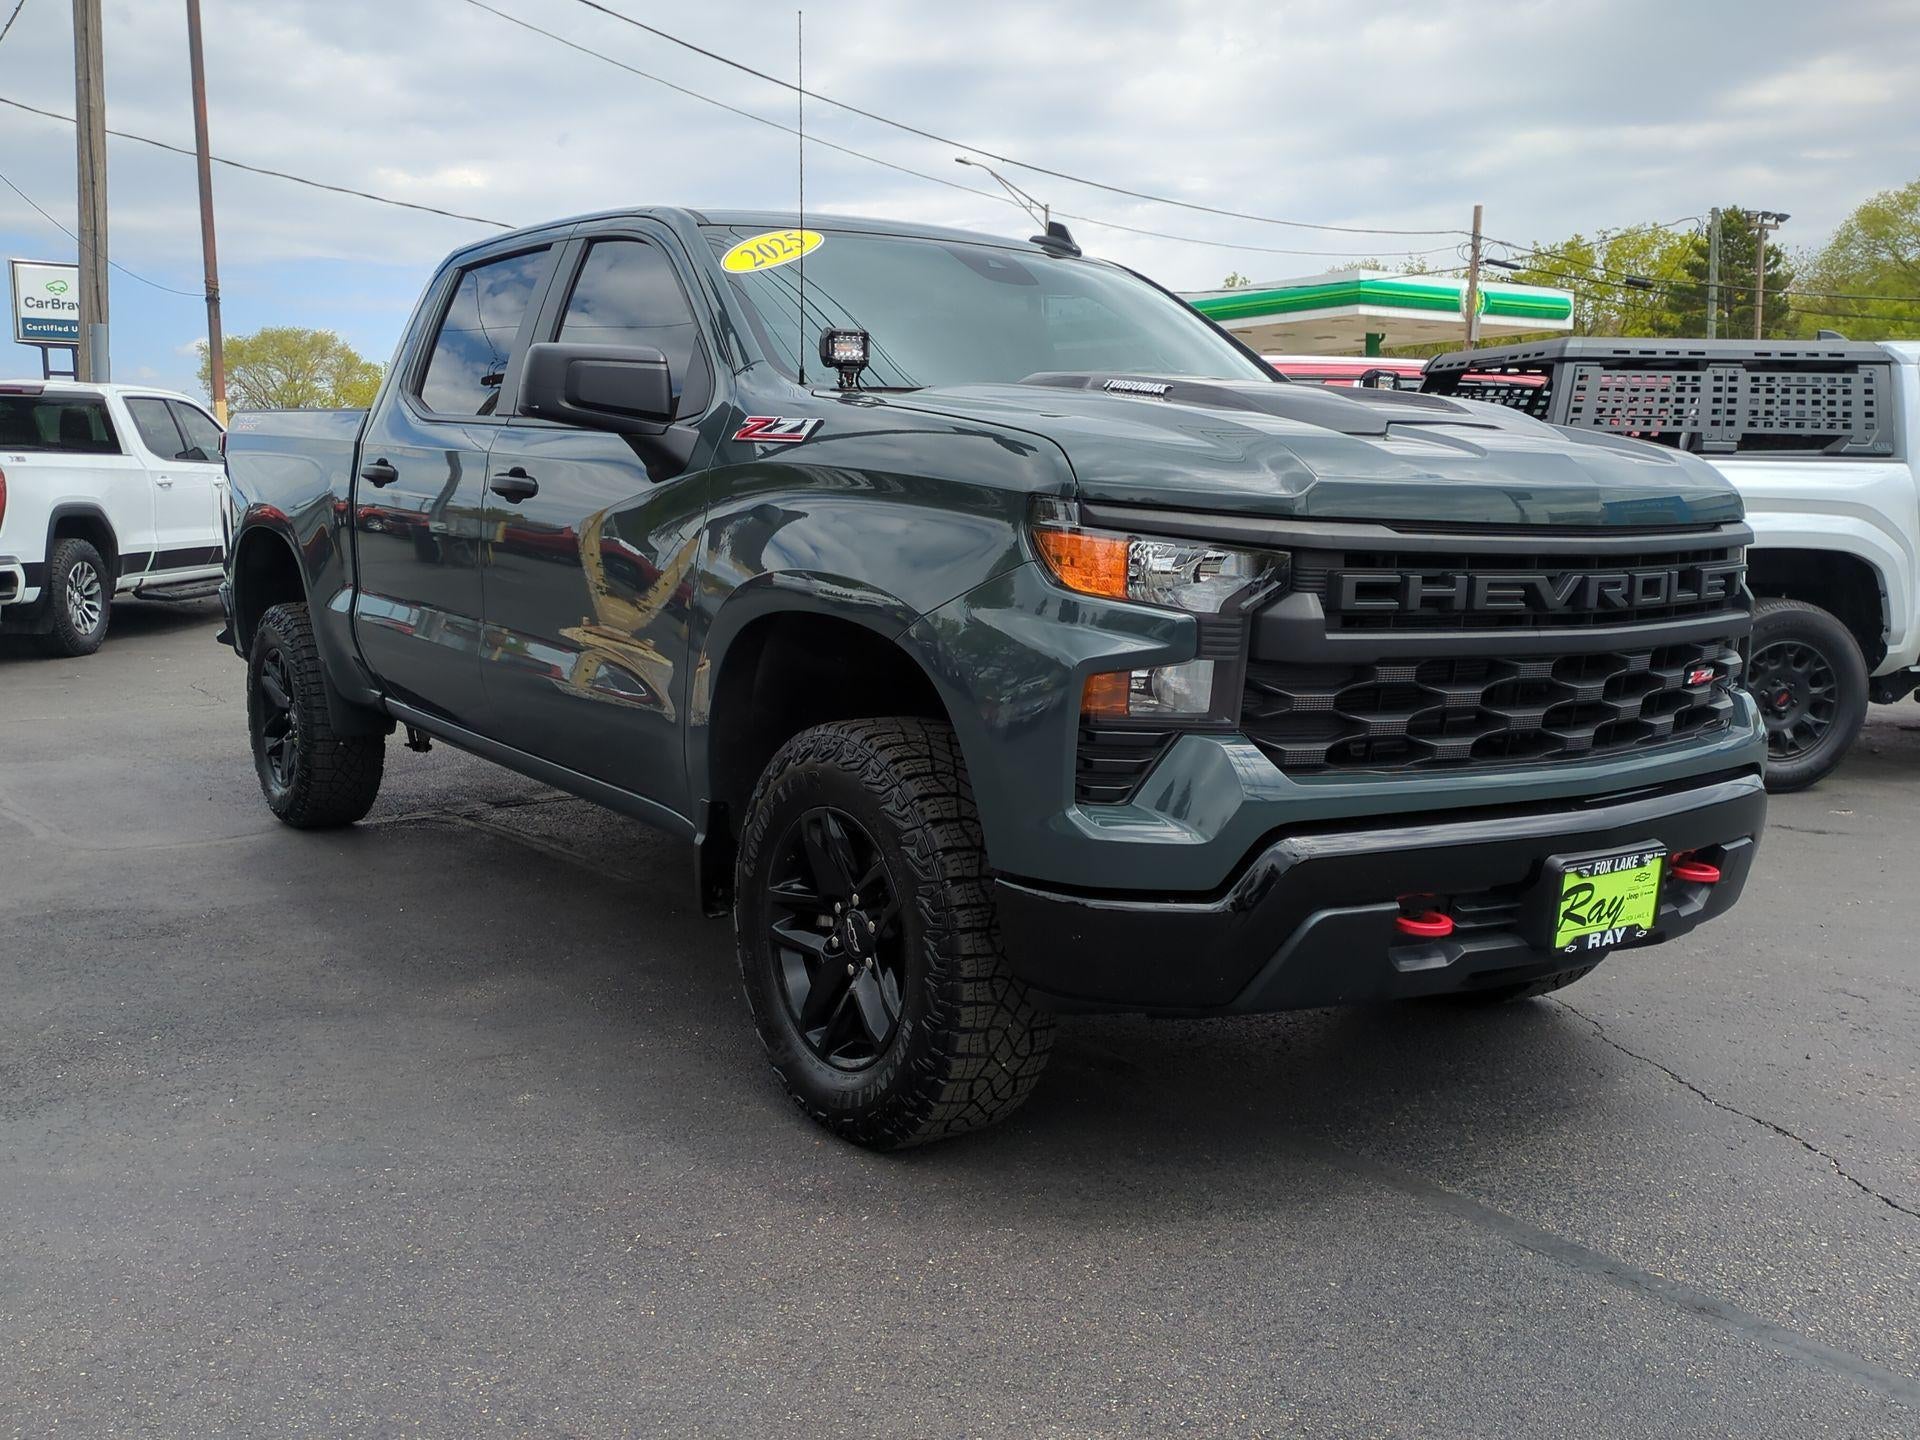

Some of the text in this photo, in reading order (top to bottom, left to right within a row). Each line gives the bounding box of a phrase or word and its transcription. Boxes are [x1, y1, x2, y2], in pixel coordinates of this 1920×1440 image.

[740, 233, 805, 267] 2025
[24, 296, 80, 311] CarBrav
[26, 323, 69, 332] Certified
[1103, 379, 1172, 395] TURBOMAX
[732, 416, 824, 443] Z71
[1593, 859, 1613, 876] FOX
[1614, 855, 1640, 871] LAKE
[1559, 882, 1626, 931] Ray
[1587, 926, 1627, 949] RAY
